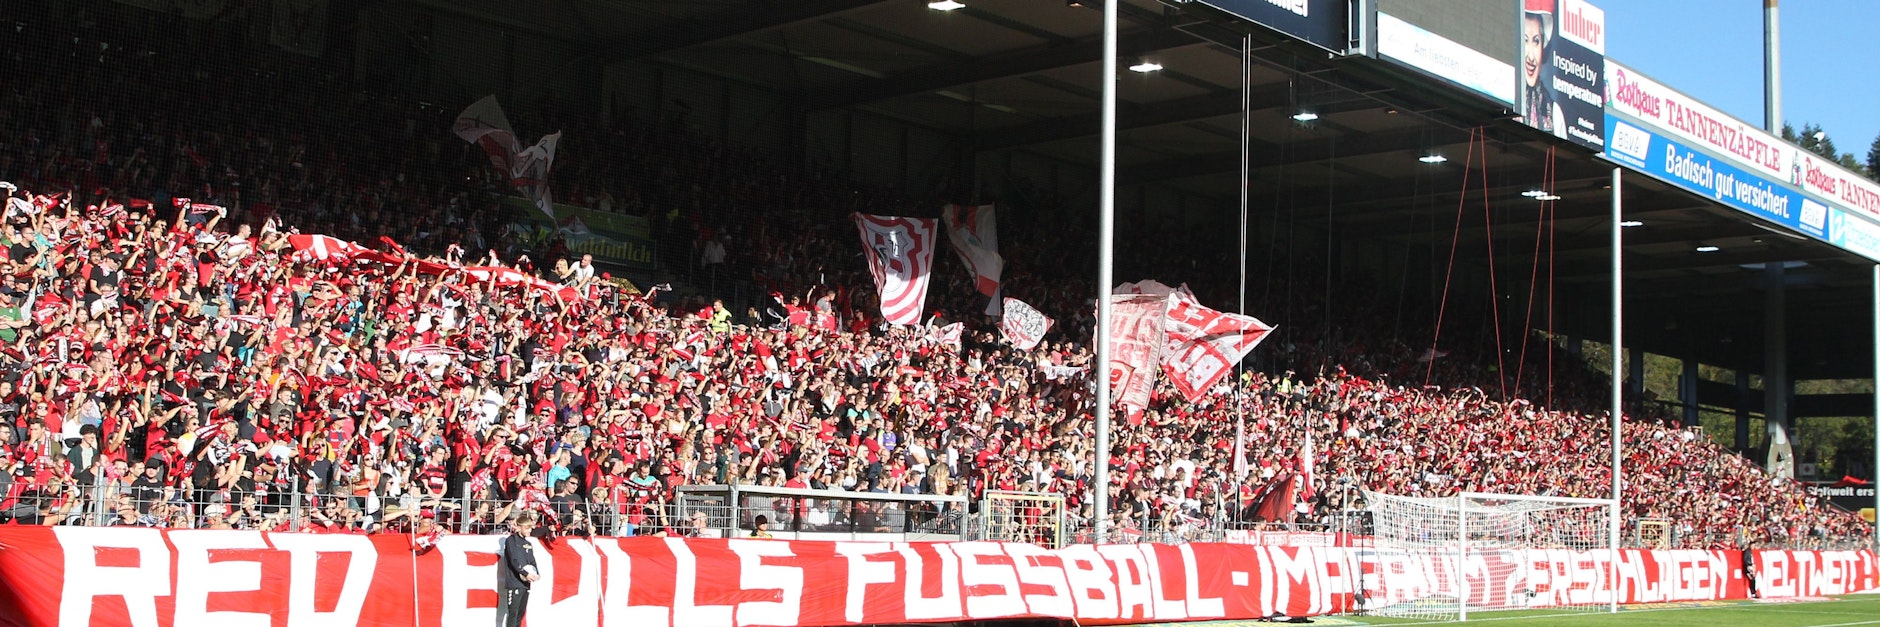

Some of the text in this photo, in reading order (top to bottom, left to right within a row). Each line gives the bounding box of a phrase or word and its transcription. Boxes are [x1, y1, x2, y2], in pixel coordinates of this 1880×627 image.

[1563, 0, 1600, 45] huber
[1553, 50, 1597, 86] Inspired by
[1552, 75, 1603, 108] temperature
[1616, 69, 1781, 172] Rothaus TANNENZÄPFLE
[1665, 143, 1713, 190] Badisch
[1715, 172, 1735, 200] gut
[1735, 180, 1790, 219] versichert.
[1805, 156, 1836, 195] Rothaus
[52, 525, 378, 627] RED
[437, 534, 803, 627] BULLS
[1500, 547, 1728, 606] ZERSCHLAGEN
